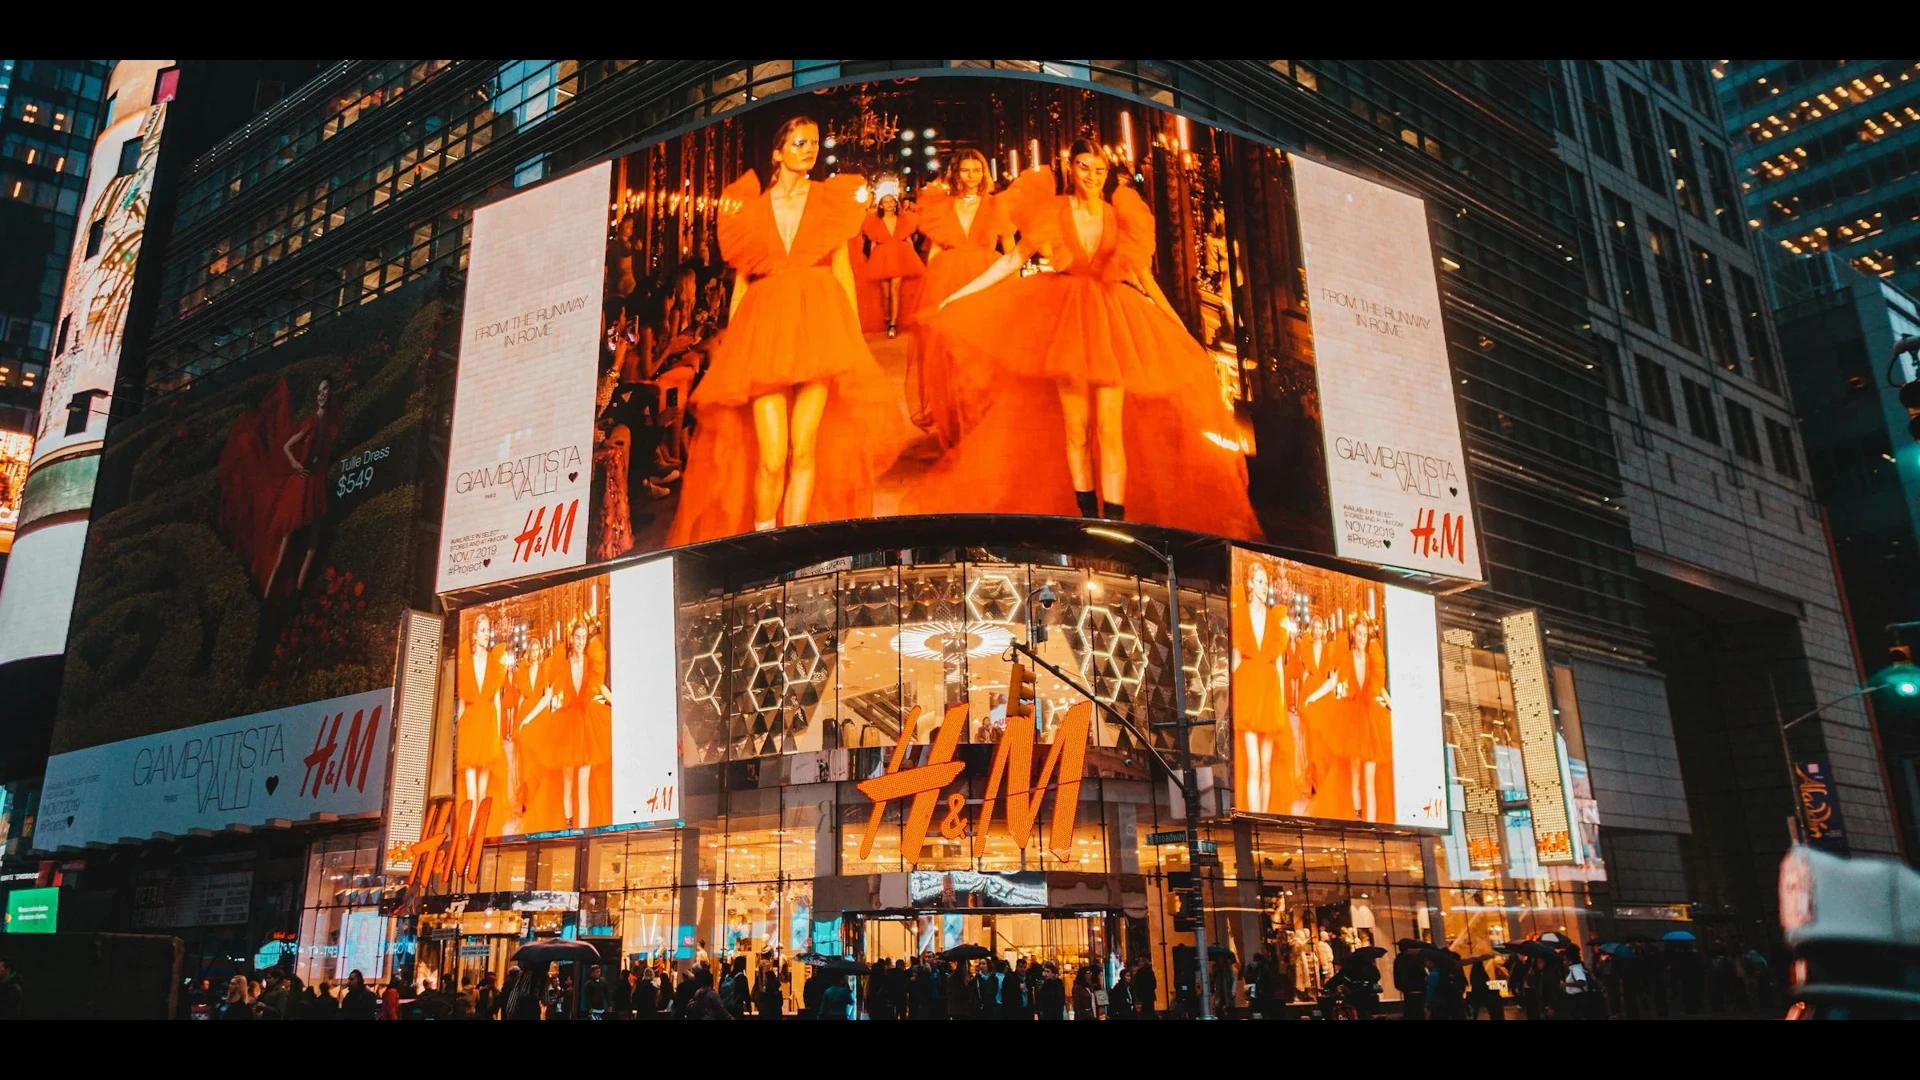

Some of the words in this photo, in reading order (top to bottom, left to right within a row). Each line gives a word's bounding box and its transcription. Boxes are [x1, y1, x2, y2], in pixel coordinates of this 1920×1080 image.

[475, 320, 508, 342] FROM
[511, 311, 535, 329] THE
[536, 295, 589, 321] RUNWAY
[1321, 288, 1357, 310] FROM
[1360, 298, 1381, 316] THE
[1384, 306, 1430, 330] RUNWAY
[1355, 313, 1368, 328] IN
[1369, 317, 1405, 339] ROME
[503, 335, 516, 348] IN
[517, 322, 554, 344] ROME
[341, 455, 361, 472] Tulle
[363, 446, 390, 465] Dress
[337, 466, 374, 498] $549
[513, 499, 580, 563] H&M
[1410, 507, 1465, 565] H&M
[300, 704, 382, 799] H&M
[856, 700, 1092, 866] H&M
[407, 796, 493, 888] H&M
[1155, 833, 1186, 844] Broadway
